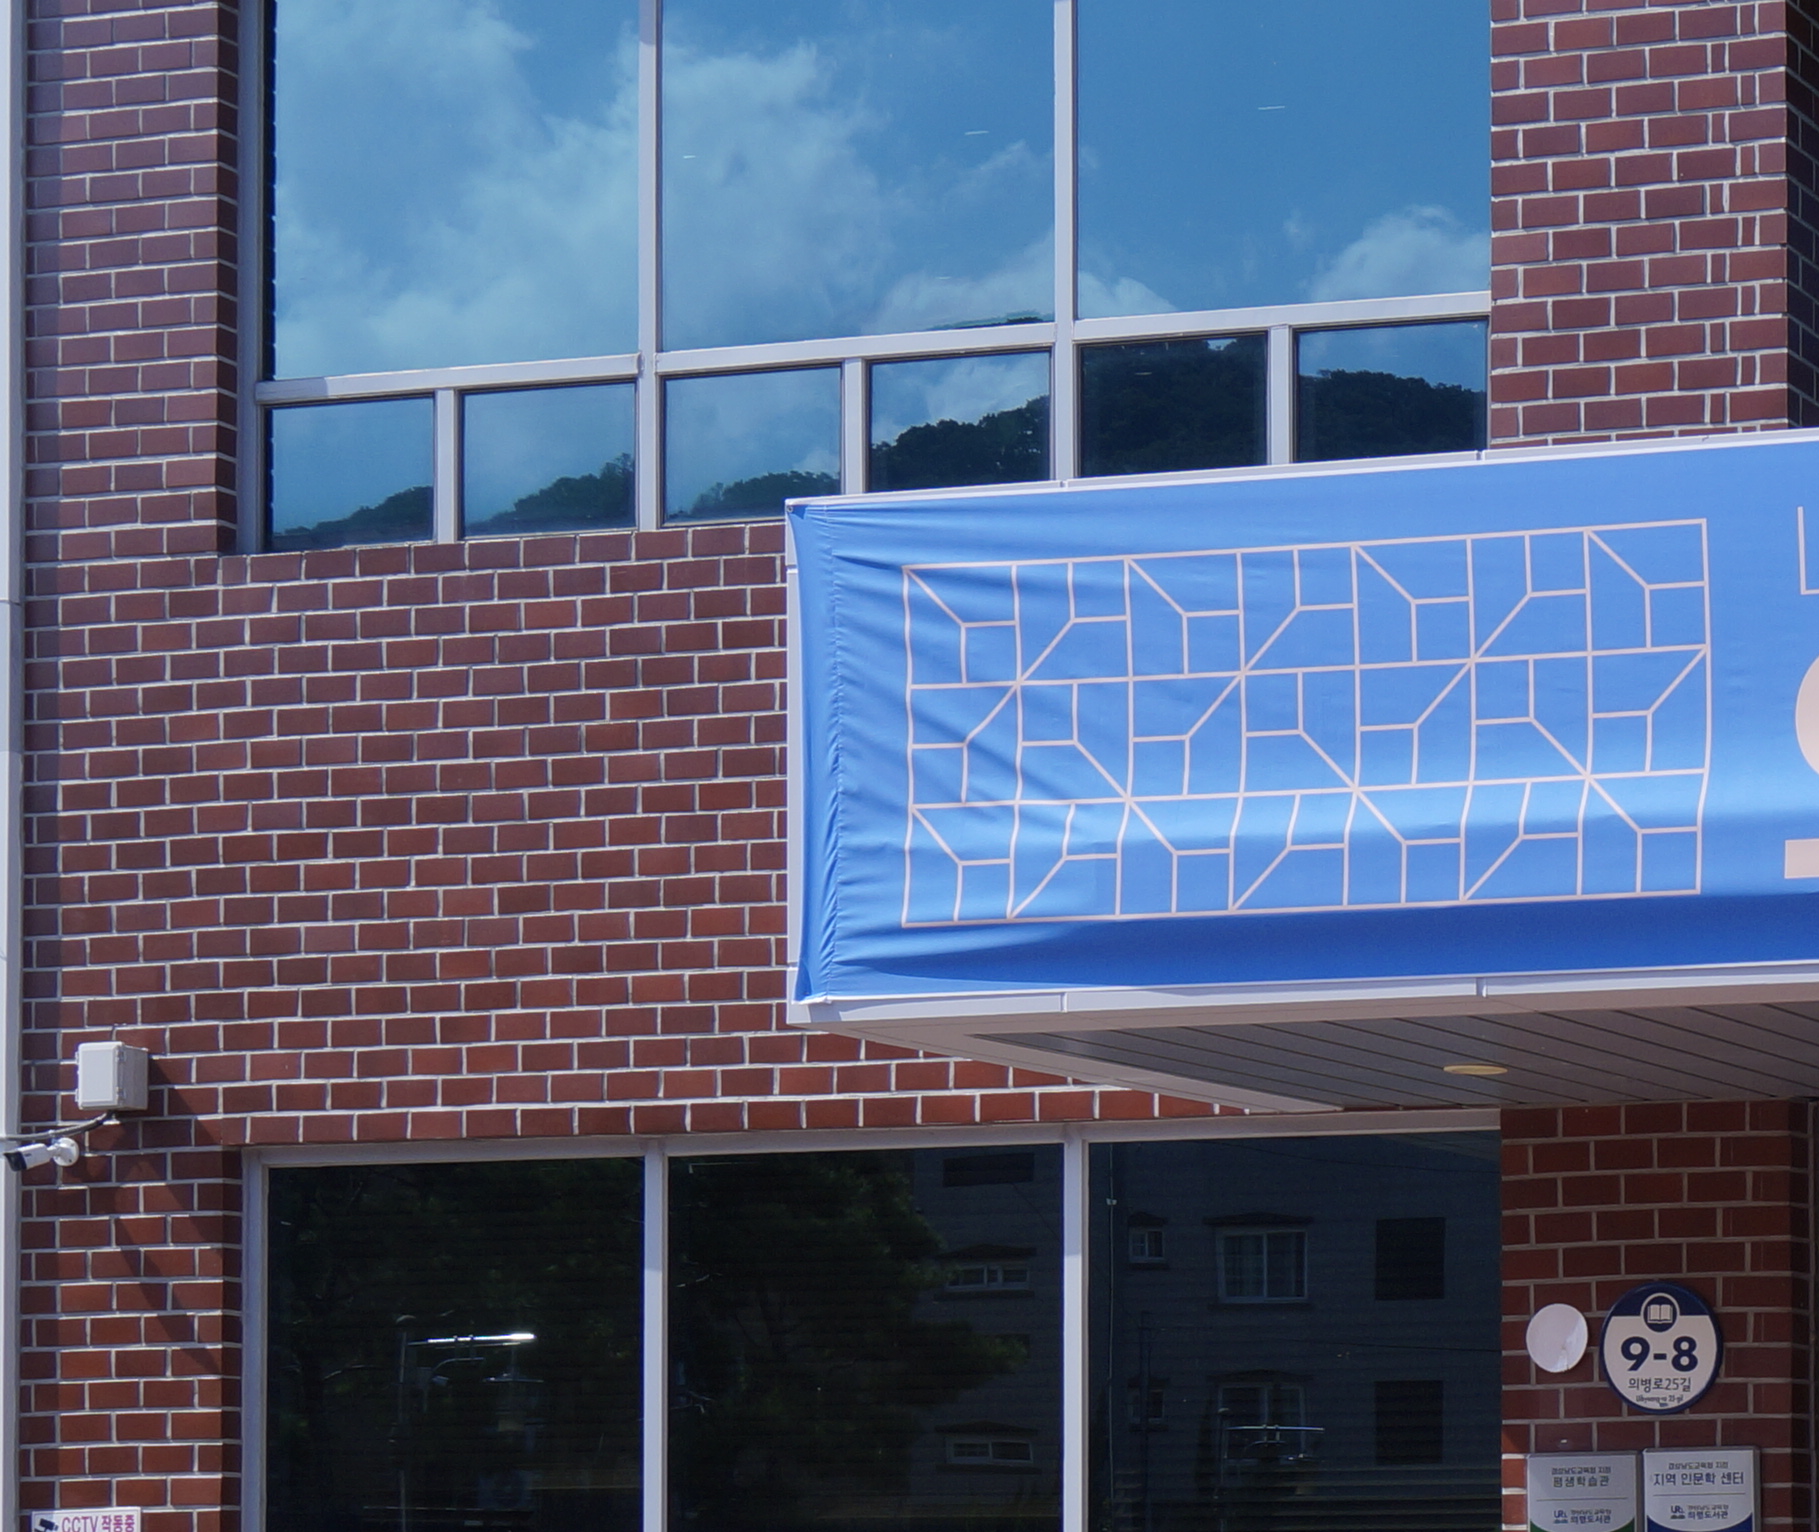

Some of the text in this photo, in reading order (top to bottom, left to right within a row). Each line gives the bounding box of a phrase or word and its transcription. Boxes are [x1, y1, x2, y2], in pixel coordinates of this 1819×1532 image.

[1621, 1335, 1698, 1372] 9-8
[1628, 1377, 1691, 1393] 의병로25길
[1553, 1475, 1610, 1488] 평생학습관
[1653, 1472, 1744, 1486] 지역 인문학 센터
[1570, 1515, 1611, 1524] 의령도서관
[1688, 1511, 1729, 1520] 의령도서관
